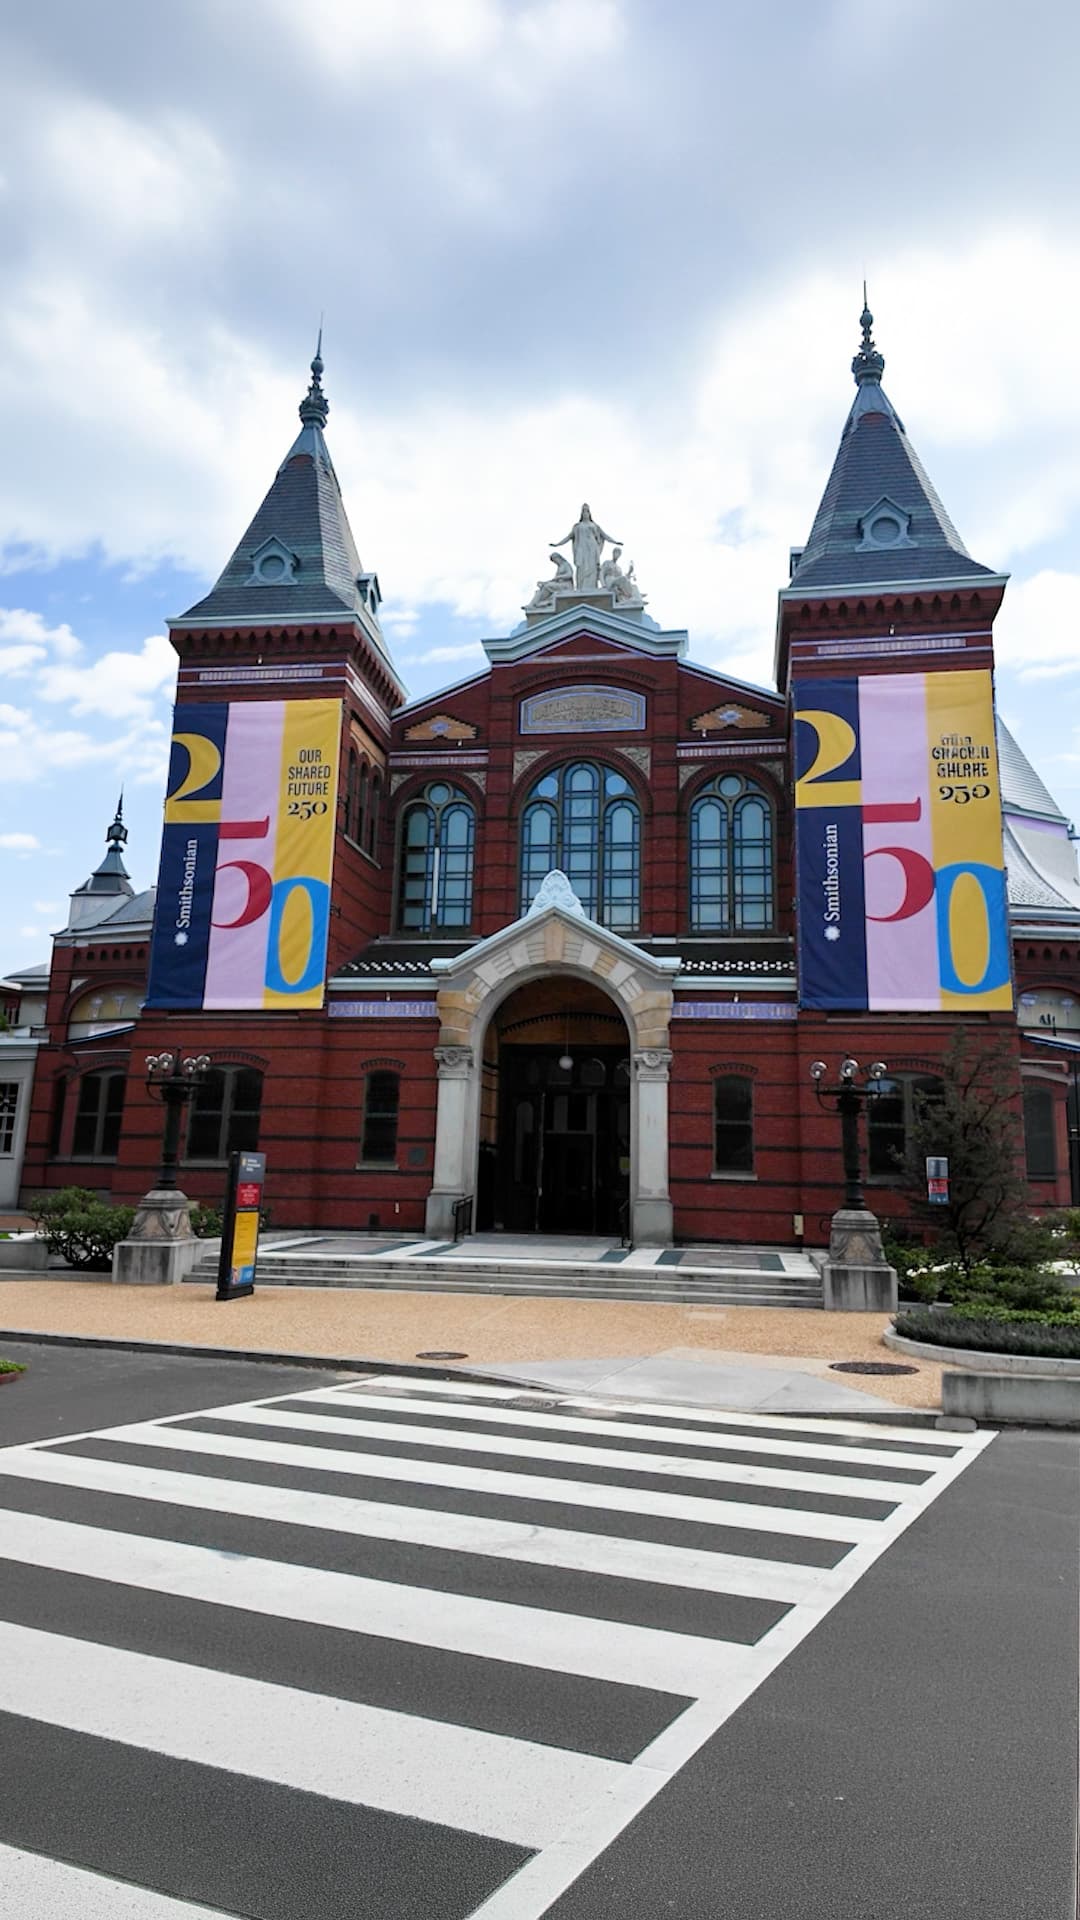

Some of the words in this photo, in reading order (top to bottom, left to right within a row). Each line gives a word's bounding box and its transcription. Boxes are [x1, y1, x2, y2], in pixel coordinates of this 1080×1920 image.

[299, 749, 322, 763] OUR
[288, 765, 331, 780] SHARED
[288, 782, 329, 796] FUTURE
[288, 801, 328, 820] 250
[822, 823, 841, 922] Smithsonian
[175, 839, 198, 929] Smithsonian
